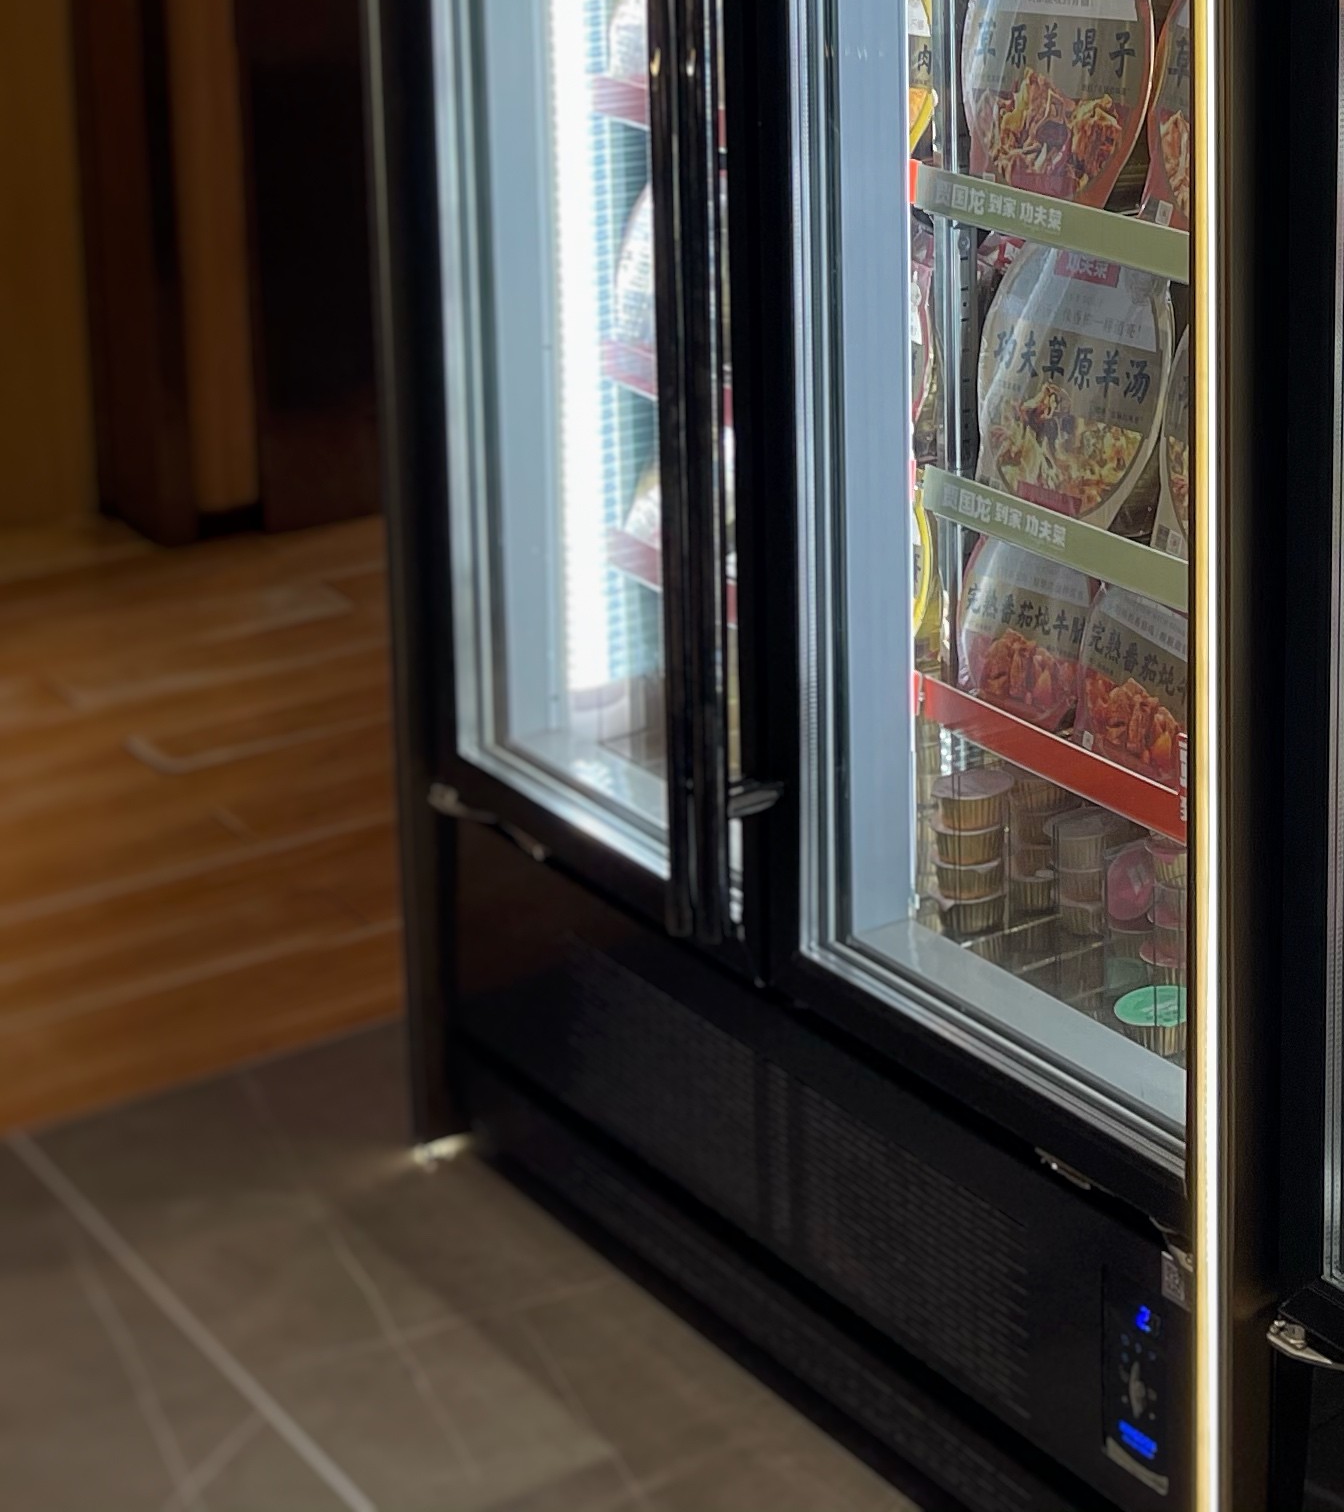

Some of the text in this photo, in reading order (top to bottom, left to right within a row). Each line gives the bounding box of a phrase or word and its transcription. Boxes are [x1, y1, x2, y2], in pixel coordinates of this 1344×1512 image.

[975, 19, 1137, 79] 草原羊蝎子
[1090, 624, 1186, 696] 完熟番茄炖
